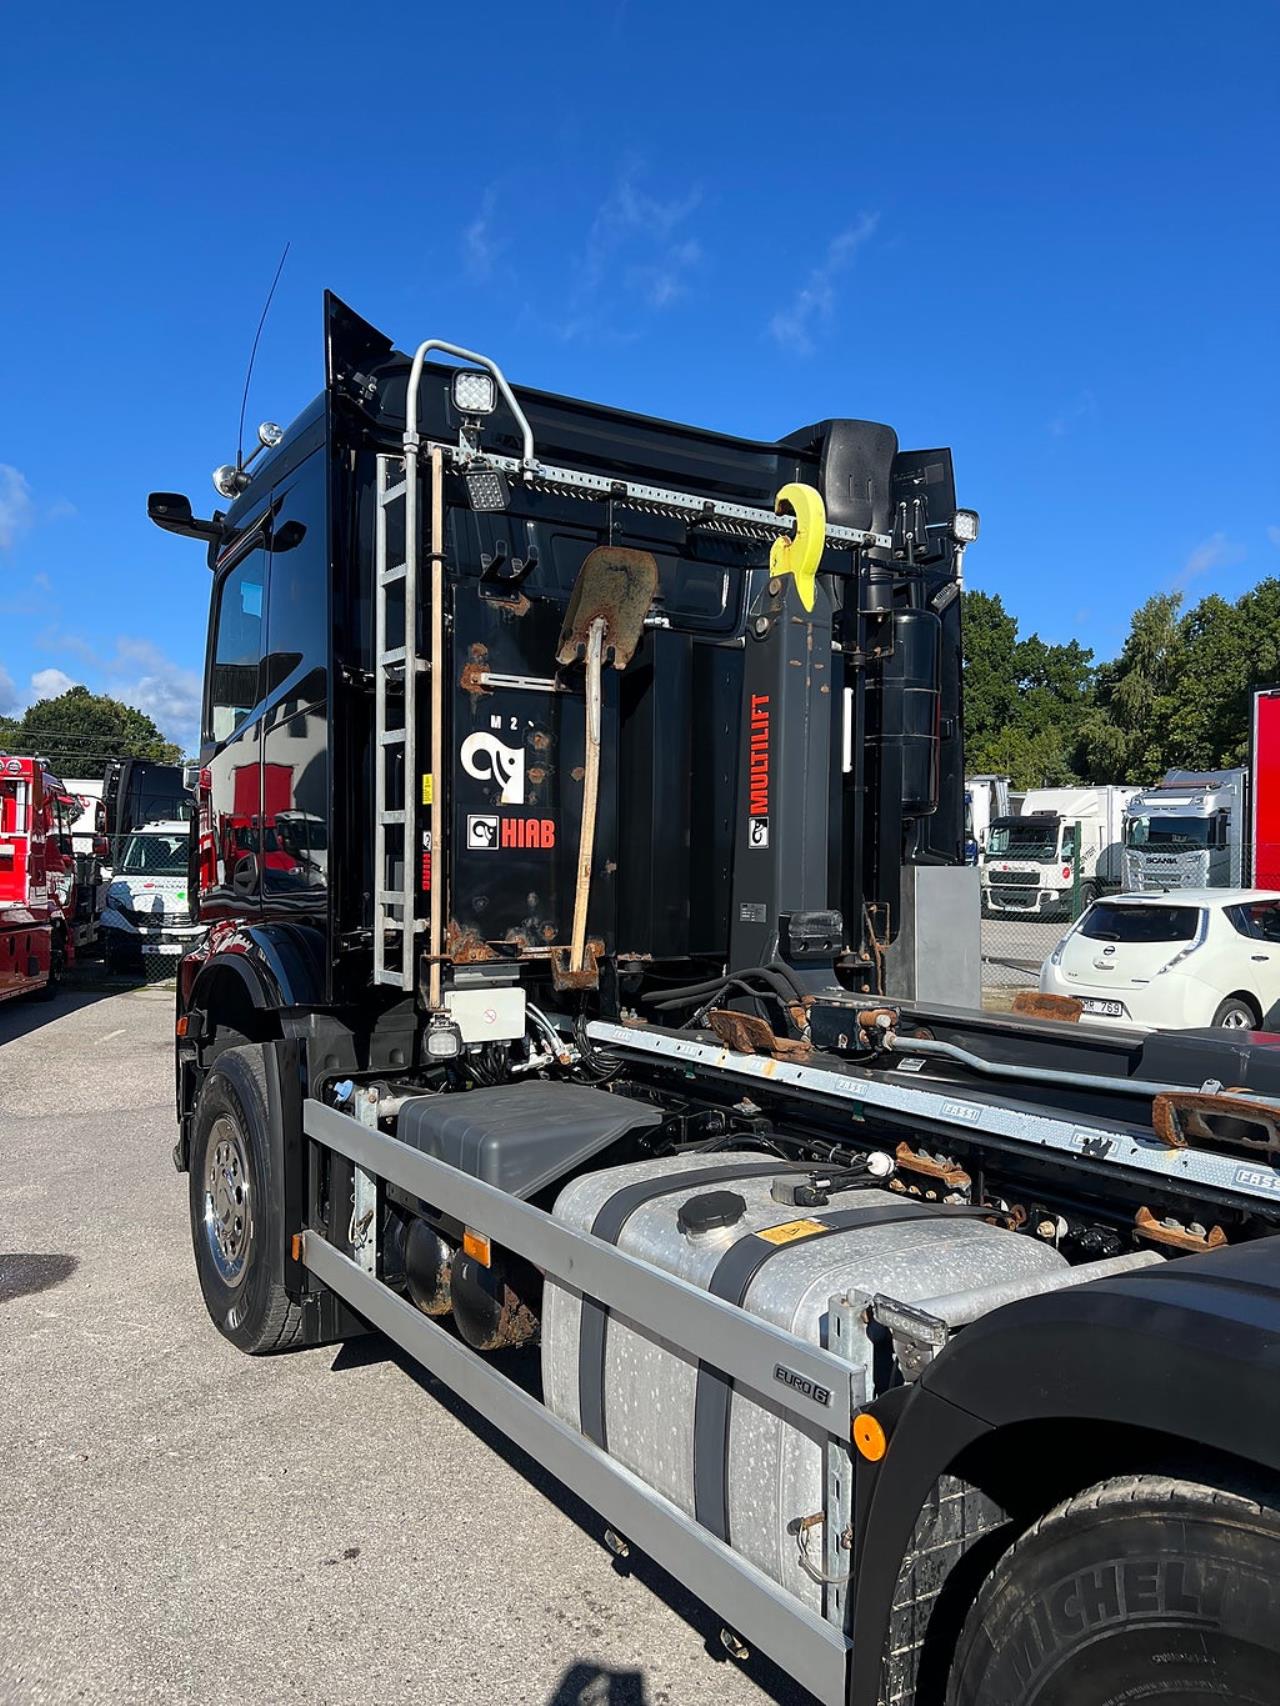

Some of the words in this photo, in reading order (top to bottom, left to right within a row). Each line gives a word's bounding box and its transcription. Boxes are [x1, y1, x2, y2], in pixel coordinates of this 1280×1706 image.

[750, 694, 770, 815] MULTILIFT
[501, 818, 556, 849] HIAB
[1146, 856, 1178, 865] SCANIA
[1101, 1001, 1120, 1014] 769
[775, 1367, 812, 1395] EURO
[813, 1384, 831, 1406] 6
